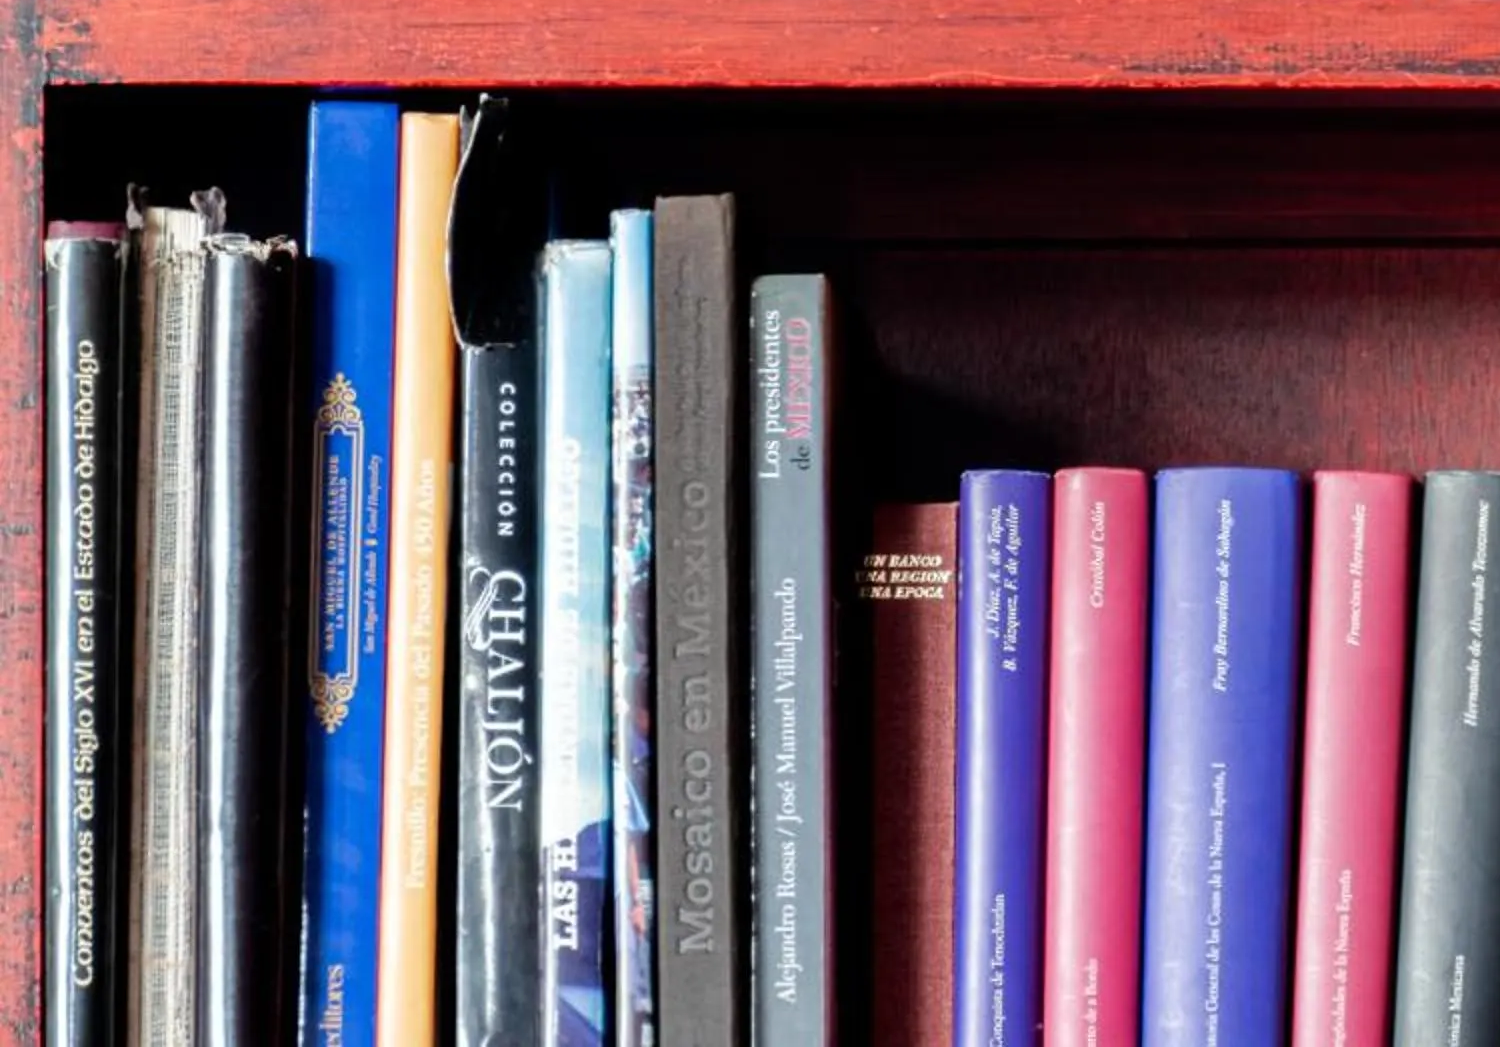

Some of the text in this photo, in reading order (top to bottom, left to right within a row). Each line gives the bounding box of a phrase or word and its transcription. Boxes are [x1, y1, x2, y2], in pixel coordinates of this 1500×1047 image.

[758, 309, 786, 478] Los presidentes
[496, 382, 518, 538] COLECCIÓN
[789, 445, 811, 471] de
[889, 555, 942, 567] BANCO
[1005, 504, 1021, 556] Aguilar
[669, 478, 713, 656] México
[73, 339, 99, 988] Conventos del Siglo XVI en el Estado de Hidalgo
[773, 577, 803, 692] Villalpando
[680, 670, 712, 731] en
[1463, 659, 1480, 727] Hernando
[773, 697, 797, 774] Manuel
[775, 780, 804, 824] José
[669, 749, 716, 954] Mosaico
[775, 841, 797, 898] Rosas
[552, 880, 580, 950] LAS
[774, 904, 804, 1003] Alejandro
